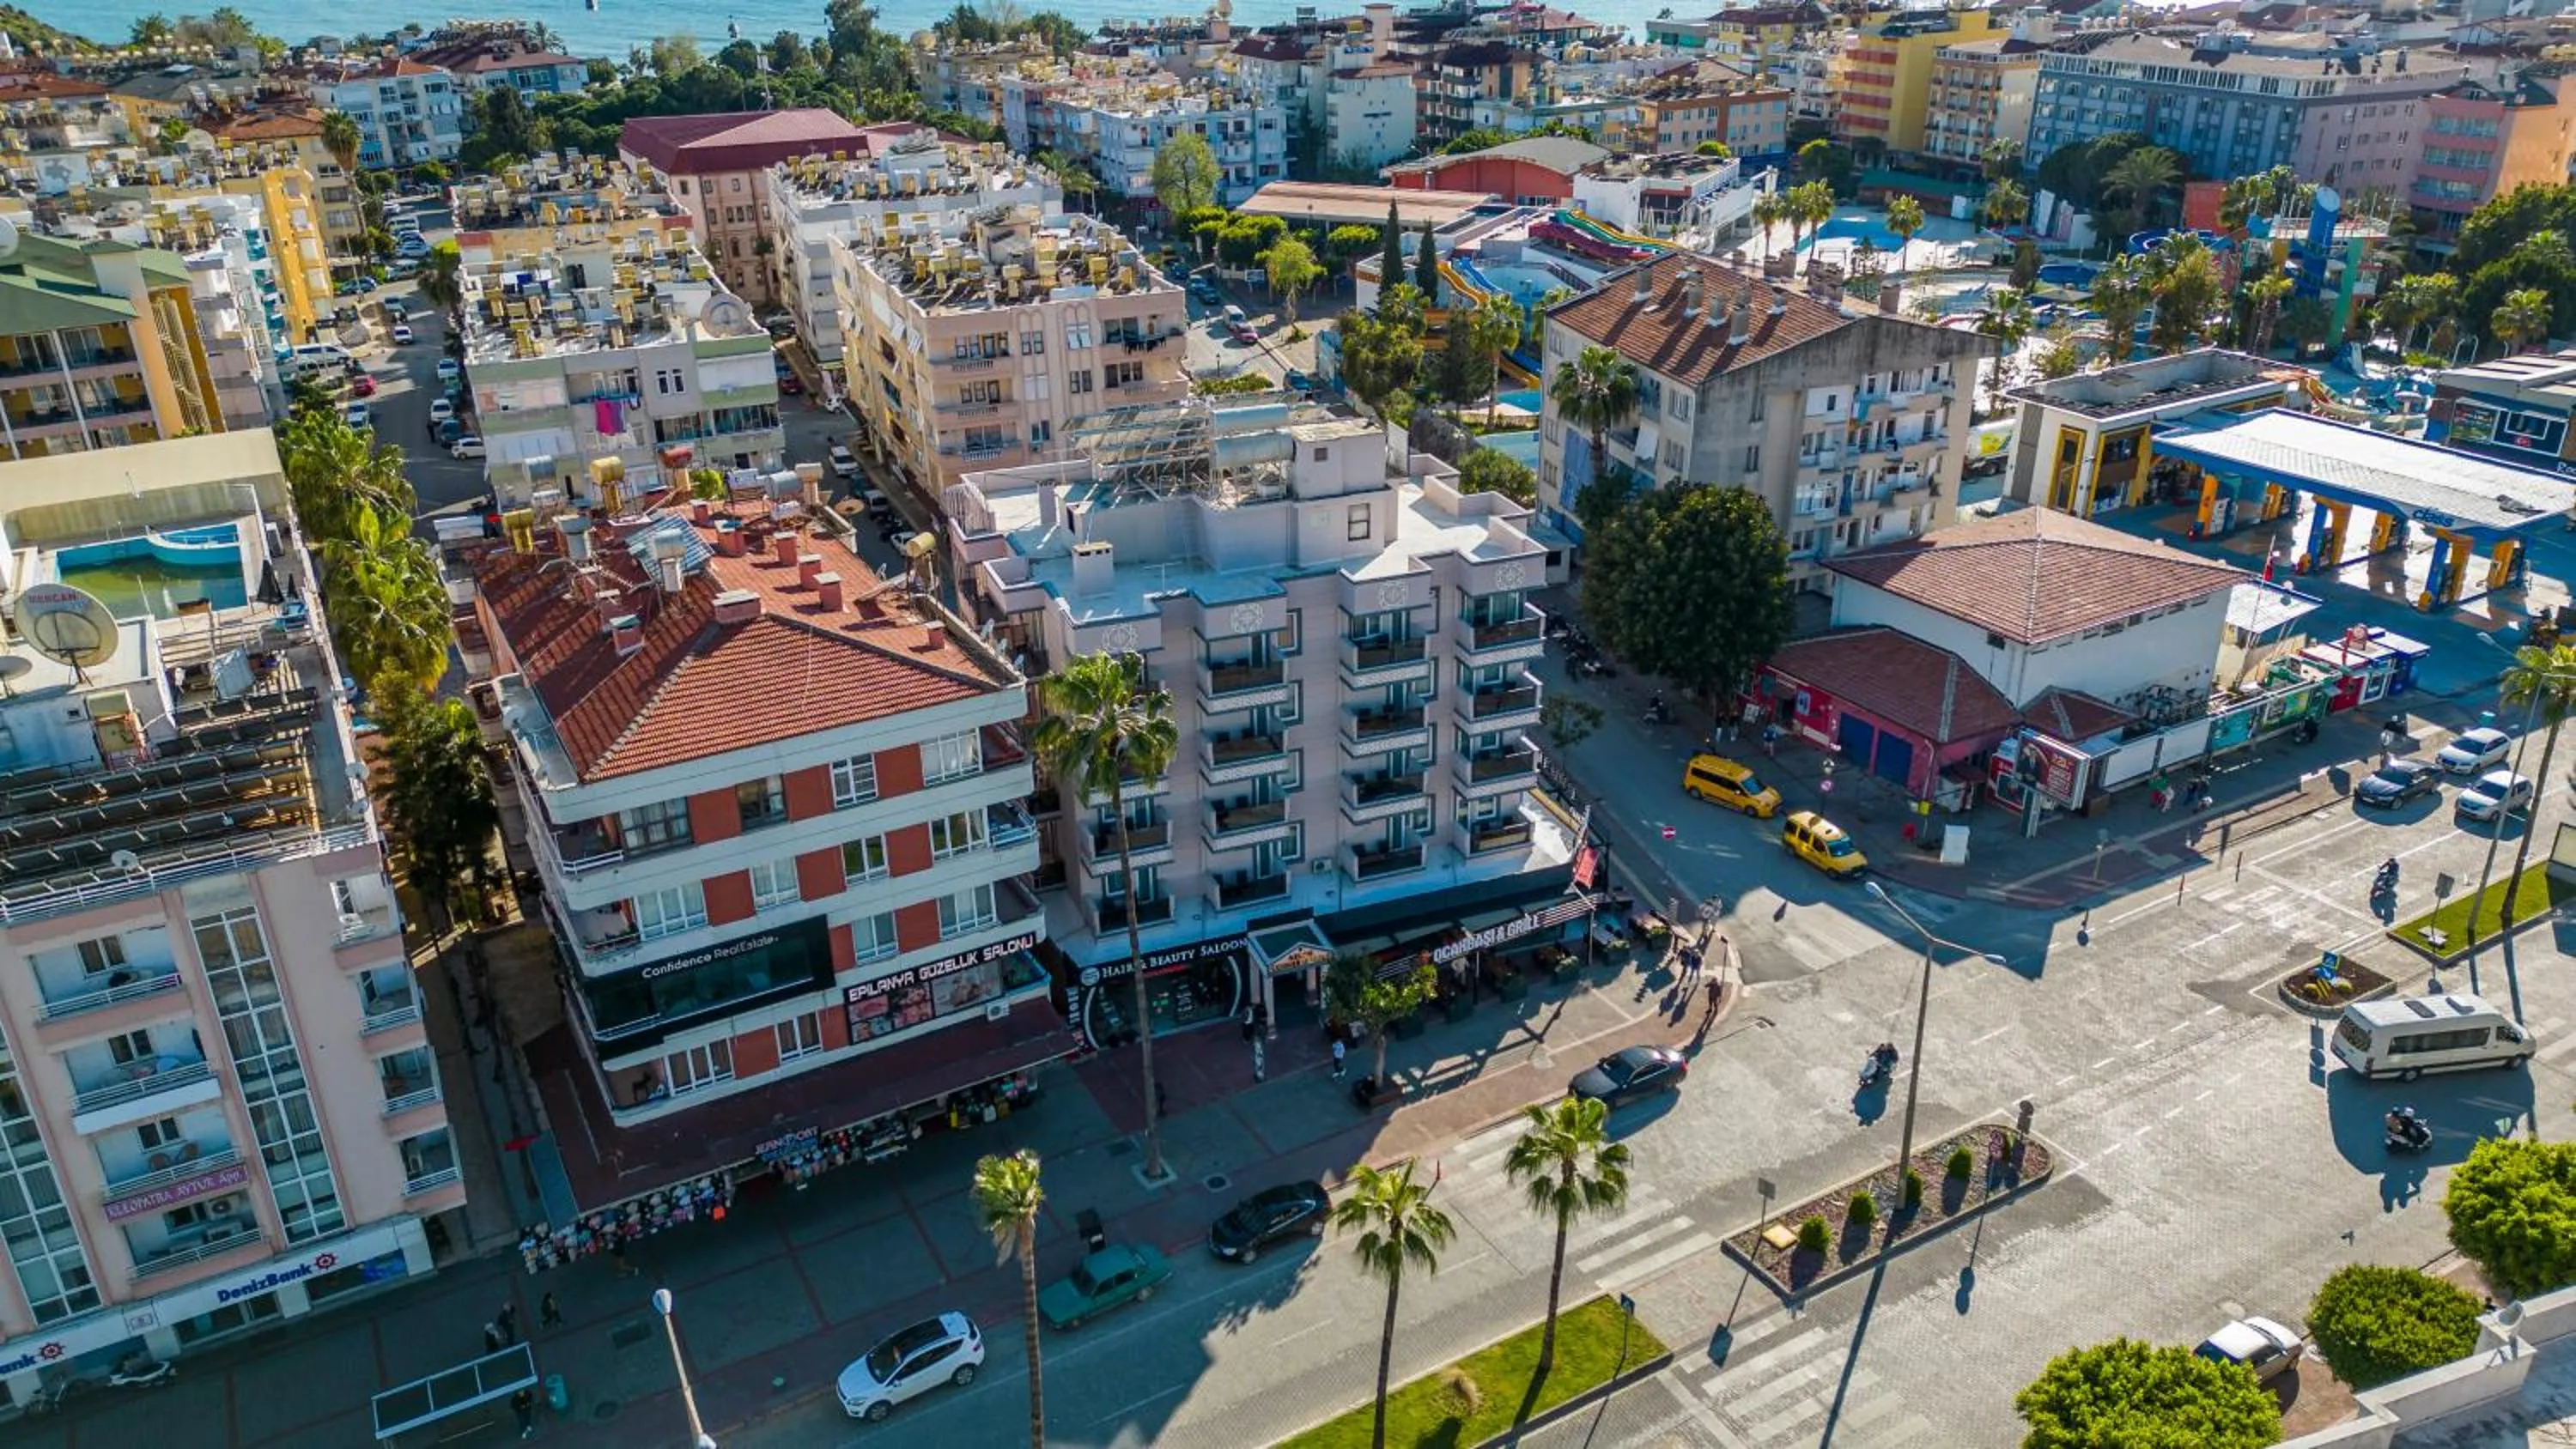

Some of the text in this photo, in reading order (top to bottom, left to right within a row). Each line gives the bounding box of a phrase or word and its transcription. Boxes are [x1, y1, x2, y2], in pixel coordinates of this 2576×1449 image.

[983, 935, 1034, 961] SALONU
[1102, 965, 1134, 979] HAIR
[1150, 949, 1196, 968] BEAUTY
[1200, 937, 1249, 957] SALOON
[641, 953, 712, 978] Confidence
[216, 1263, 313, 1303] DenizBank
